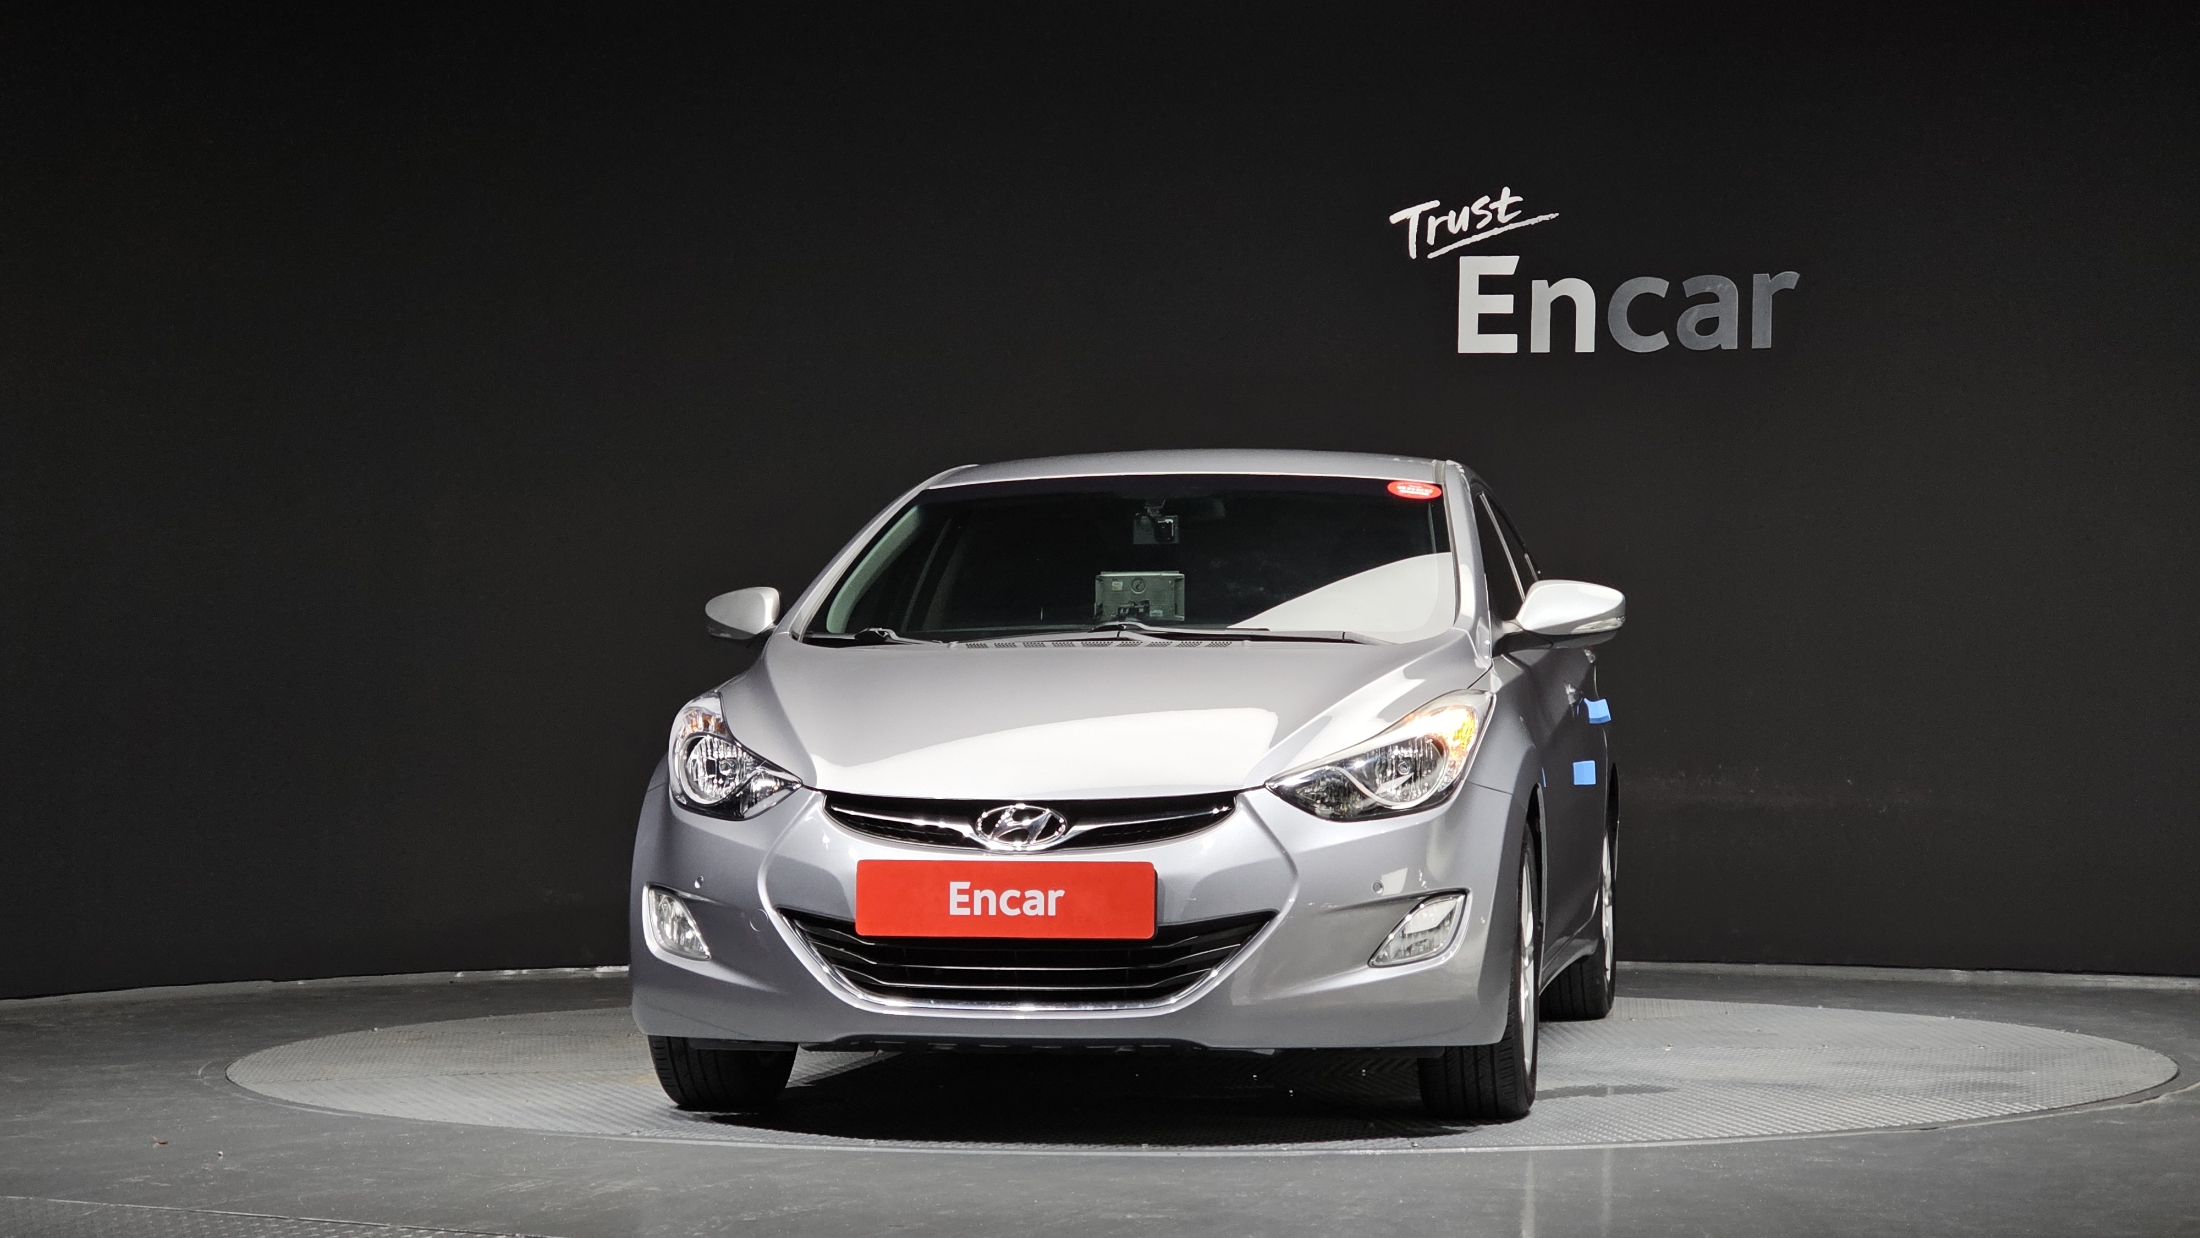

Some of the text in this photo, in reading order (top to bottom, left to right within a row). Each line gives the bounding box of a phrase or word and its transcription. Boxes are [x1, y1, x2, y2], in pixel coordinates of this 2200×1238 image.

[1389, 187, 1524, 260] Trust
[1457, 255, 1800, 354] Encar
[949, 880, 1066, 917] Encar
